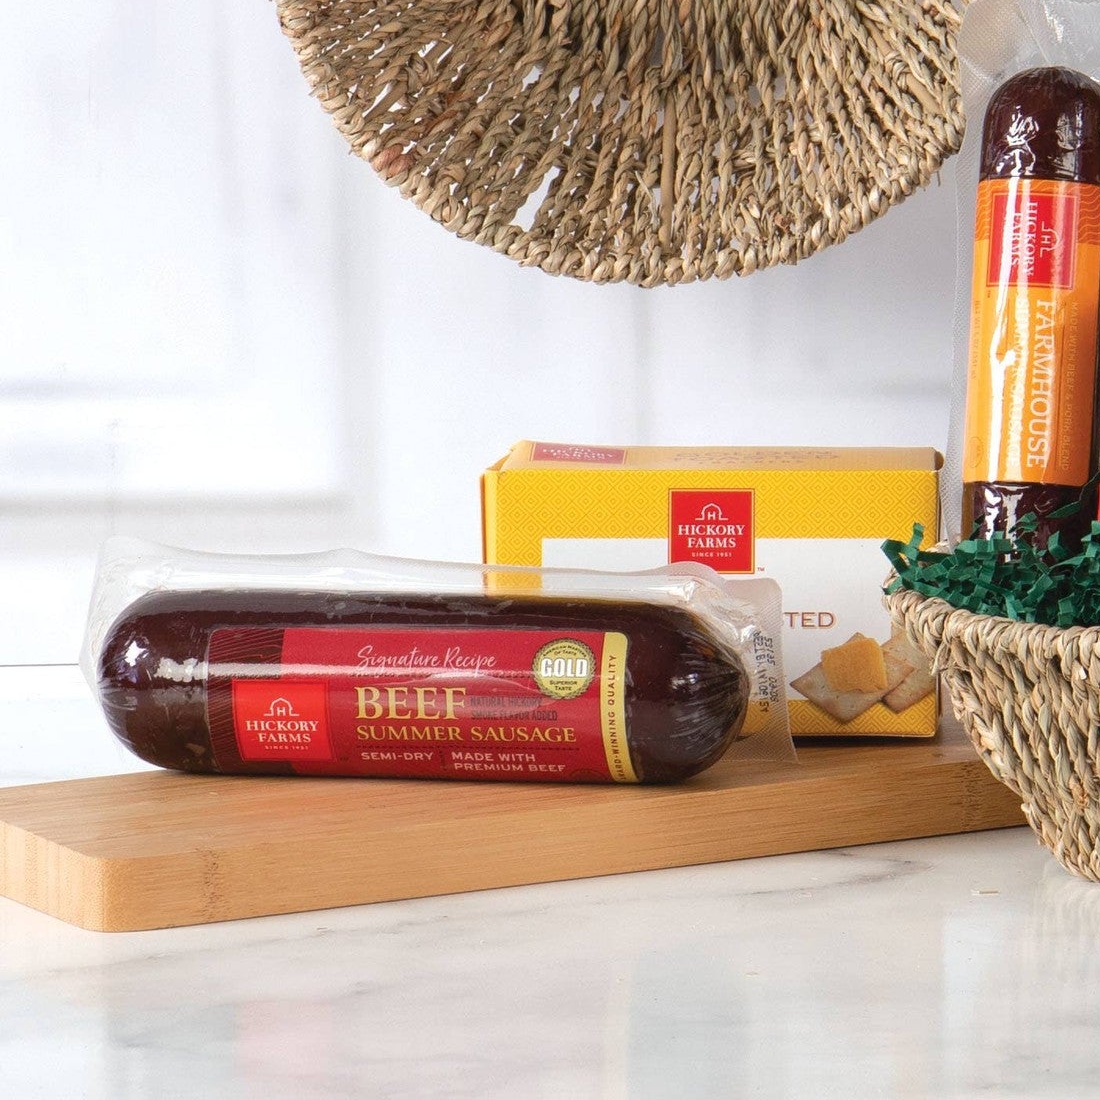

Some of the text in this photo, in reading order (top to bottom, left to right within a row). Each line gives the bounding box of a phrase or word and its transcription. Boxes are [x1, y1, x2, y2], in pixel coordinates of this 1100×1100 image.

[1011, 211, 1024, 267] FARMS
[1022, 201, 1038, 277] HICKORY
[1069, 302, 1079, 331] MADE
[1068, 334, 1078, 361] WITH
[1026, 300, 1056, 468] FARMHOUSE
[1065, 363, 1075, 391] BEEF
[1063, 404, 1074, 431] PORK
[1061, 434, 1072, 471] BLEND
[677, 524, 745, 536] HICKORY
[687, 537, 737, 548] FARMS
[783, 612, 835, 628] TED
[355, 645, 496, 677] Signature Recipe
[541, 658, 588, 677] GOLD
[608, 655, 617, 706] QUALITY
[354, 686, 467, 720] BEEF
[471, 696, 542, 706] NATURAL HICKORY
[471, 710, 558, 721] SMOKE FLAVOR ADDED
[245, 720, 319, 732] HICKORY
[356, 725, 577, 743] SUMMER SAUSAGE
[257, 733, 311, 743] FARMS
[360, 751, 433, 760] SEMI-DRY
[451, 751, 536, 762] MADE WITH
[454, 762, 566, 772] PREMIUM BEEF
